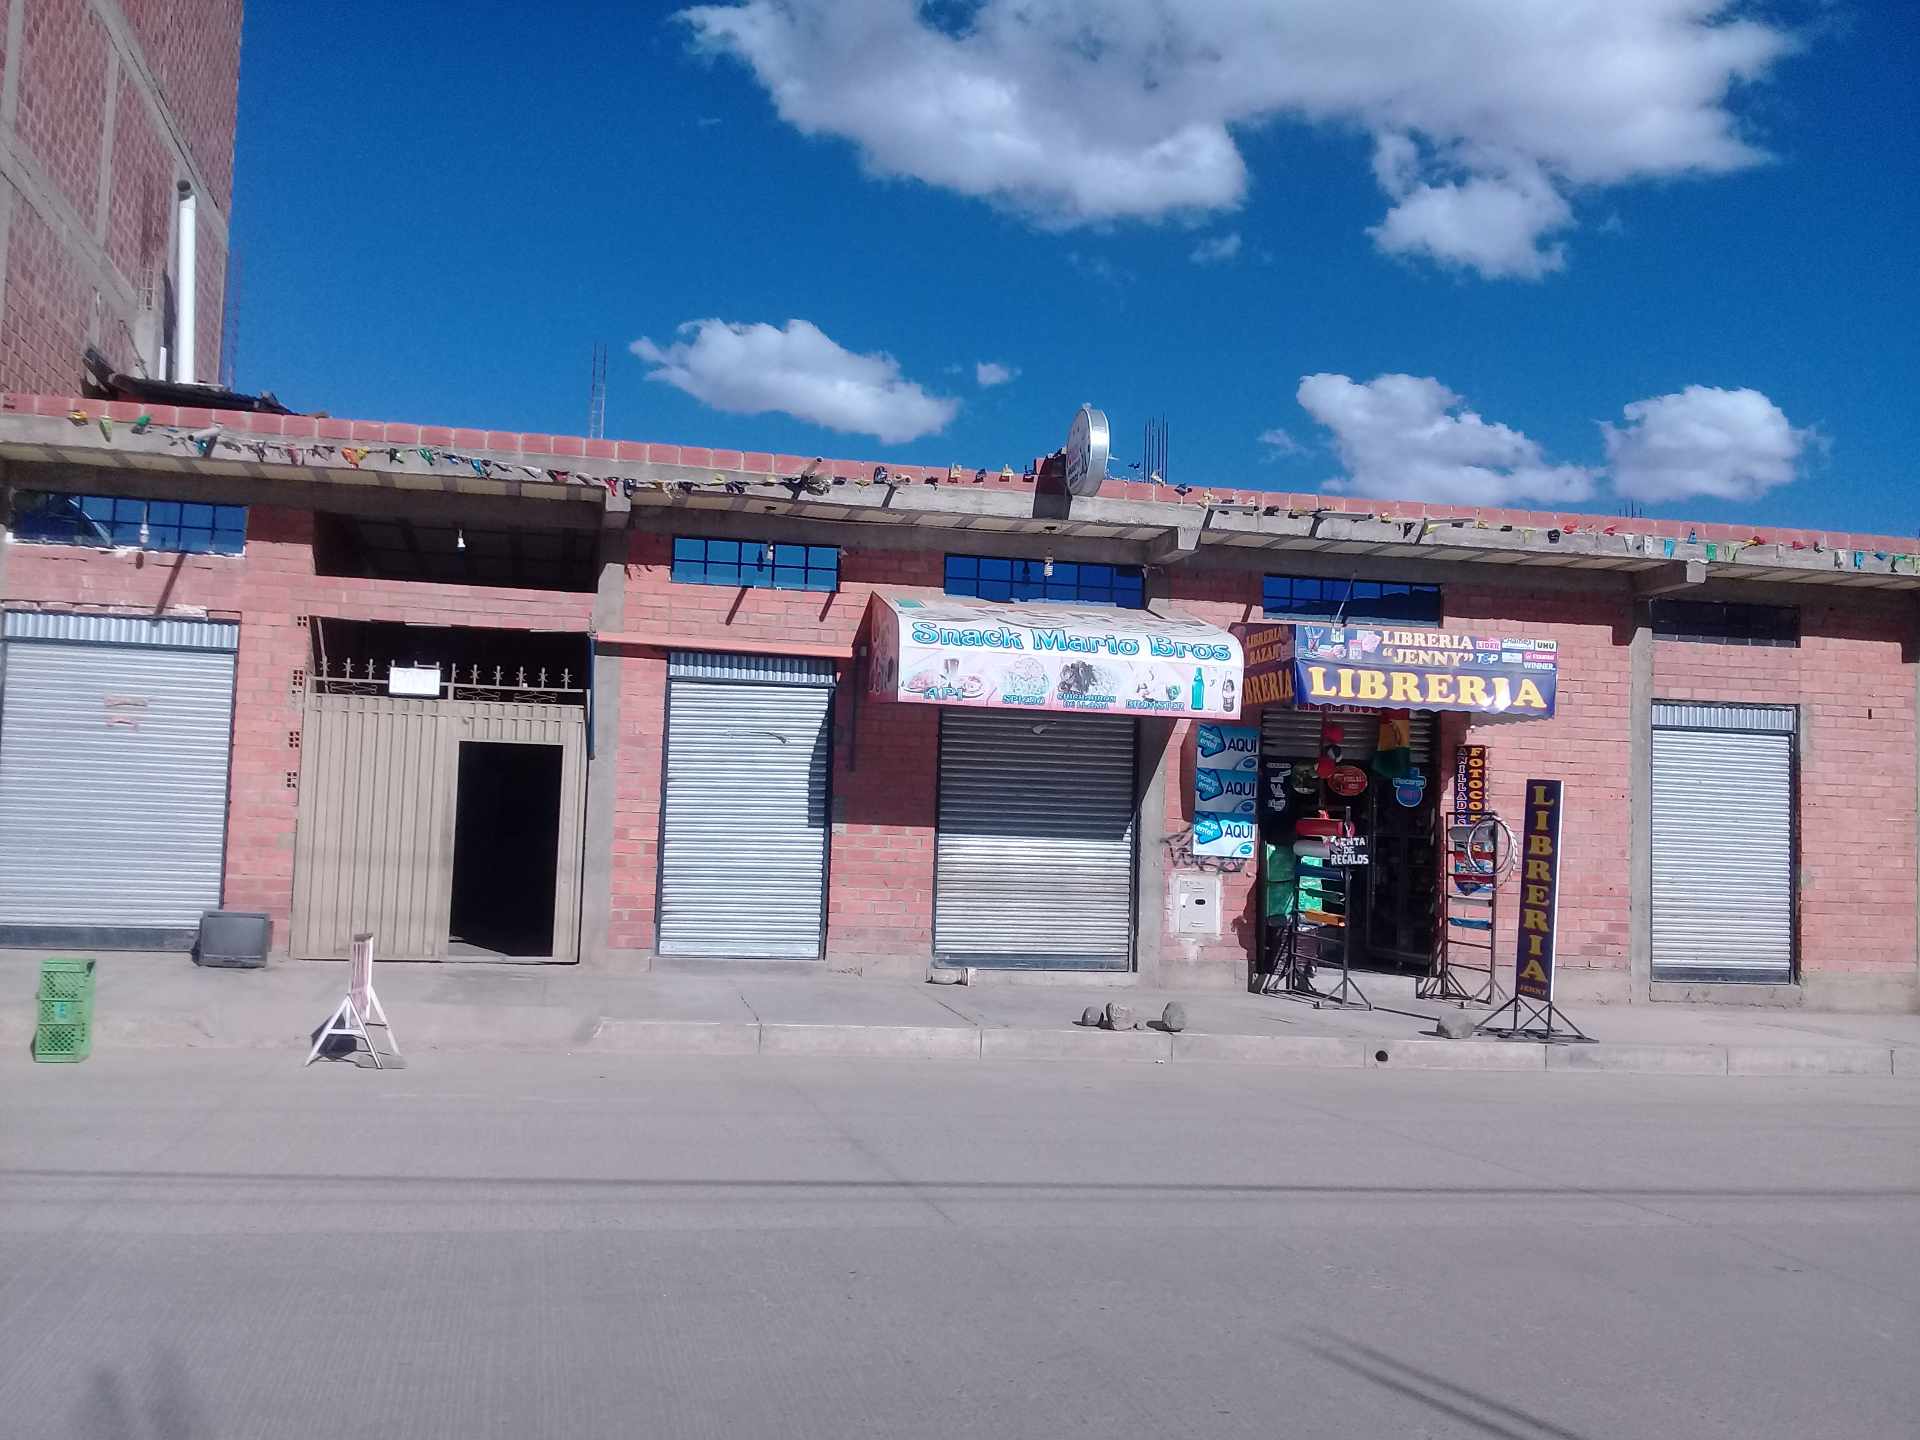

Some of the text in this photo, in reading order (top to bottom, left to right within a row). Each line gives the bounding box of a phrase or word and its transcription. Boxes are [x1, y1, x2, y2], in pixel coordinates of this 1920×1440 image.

[911, 621, 1232, 661] Snack Mario Bros
[1382, 630, 1474, 650] LIBRERIA
[1308, 666, 1547, 708] LIBRERIA
[1227, 738, 1257, 753] AQUI
[1225, 780, 1255, 796] AQUI
[1224, 823, 1253, 839] AQUI
[1331, 853, 1369, 865] REGALOS
[1519, 785, 1554, 982] LIBRERIA
